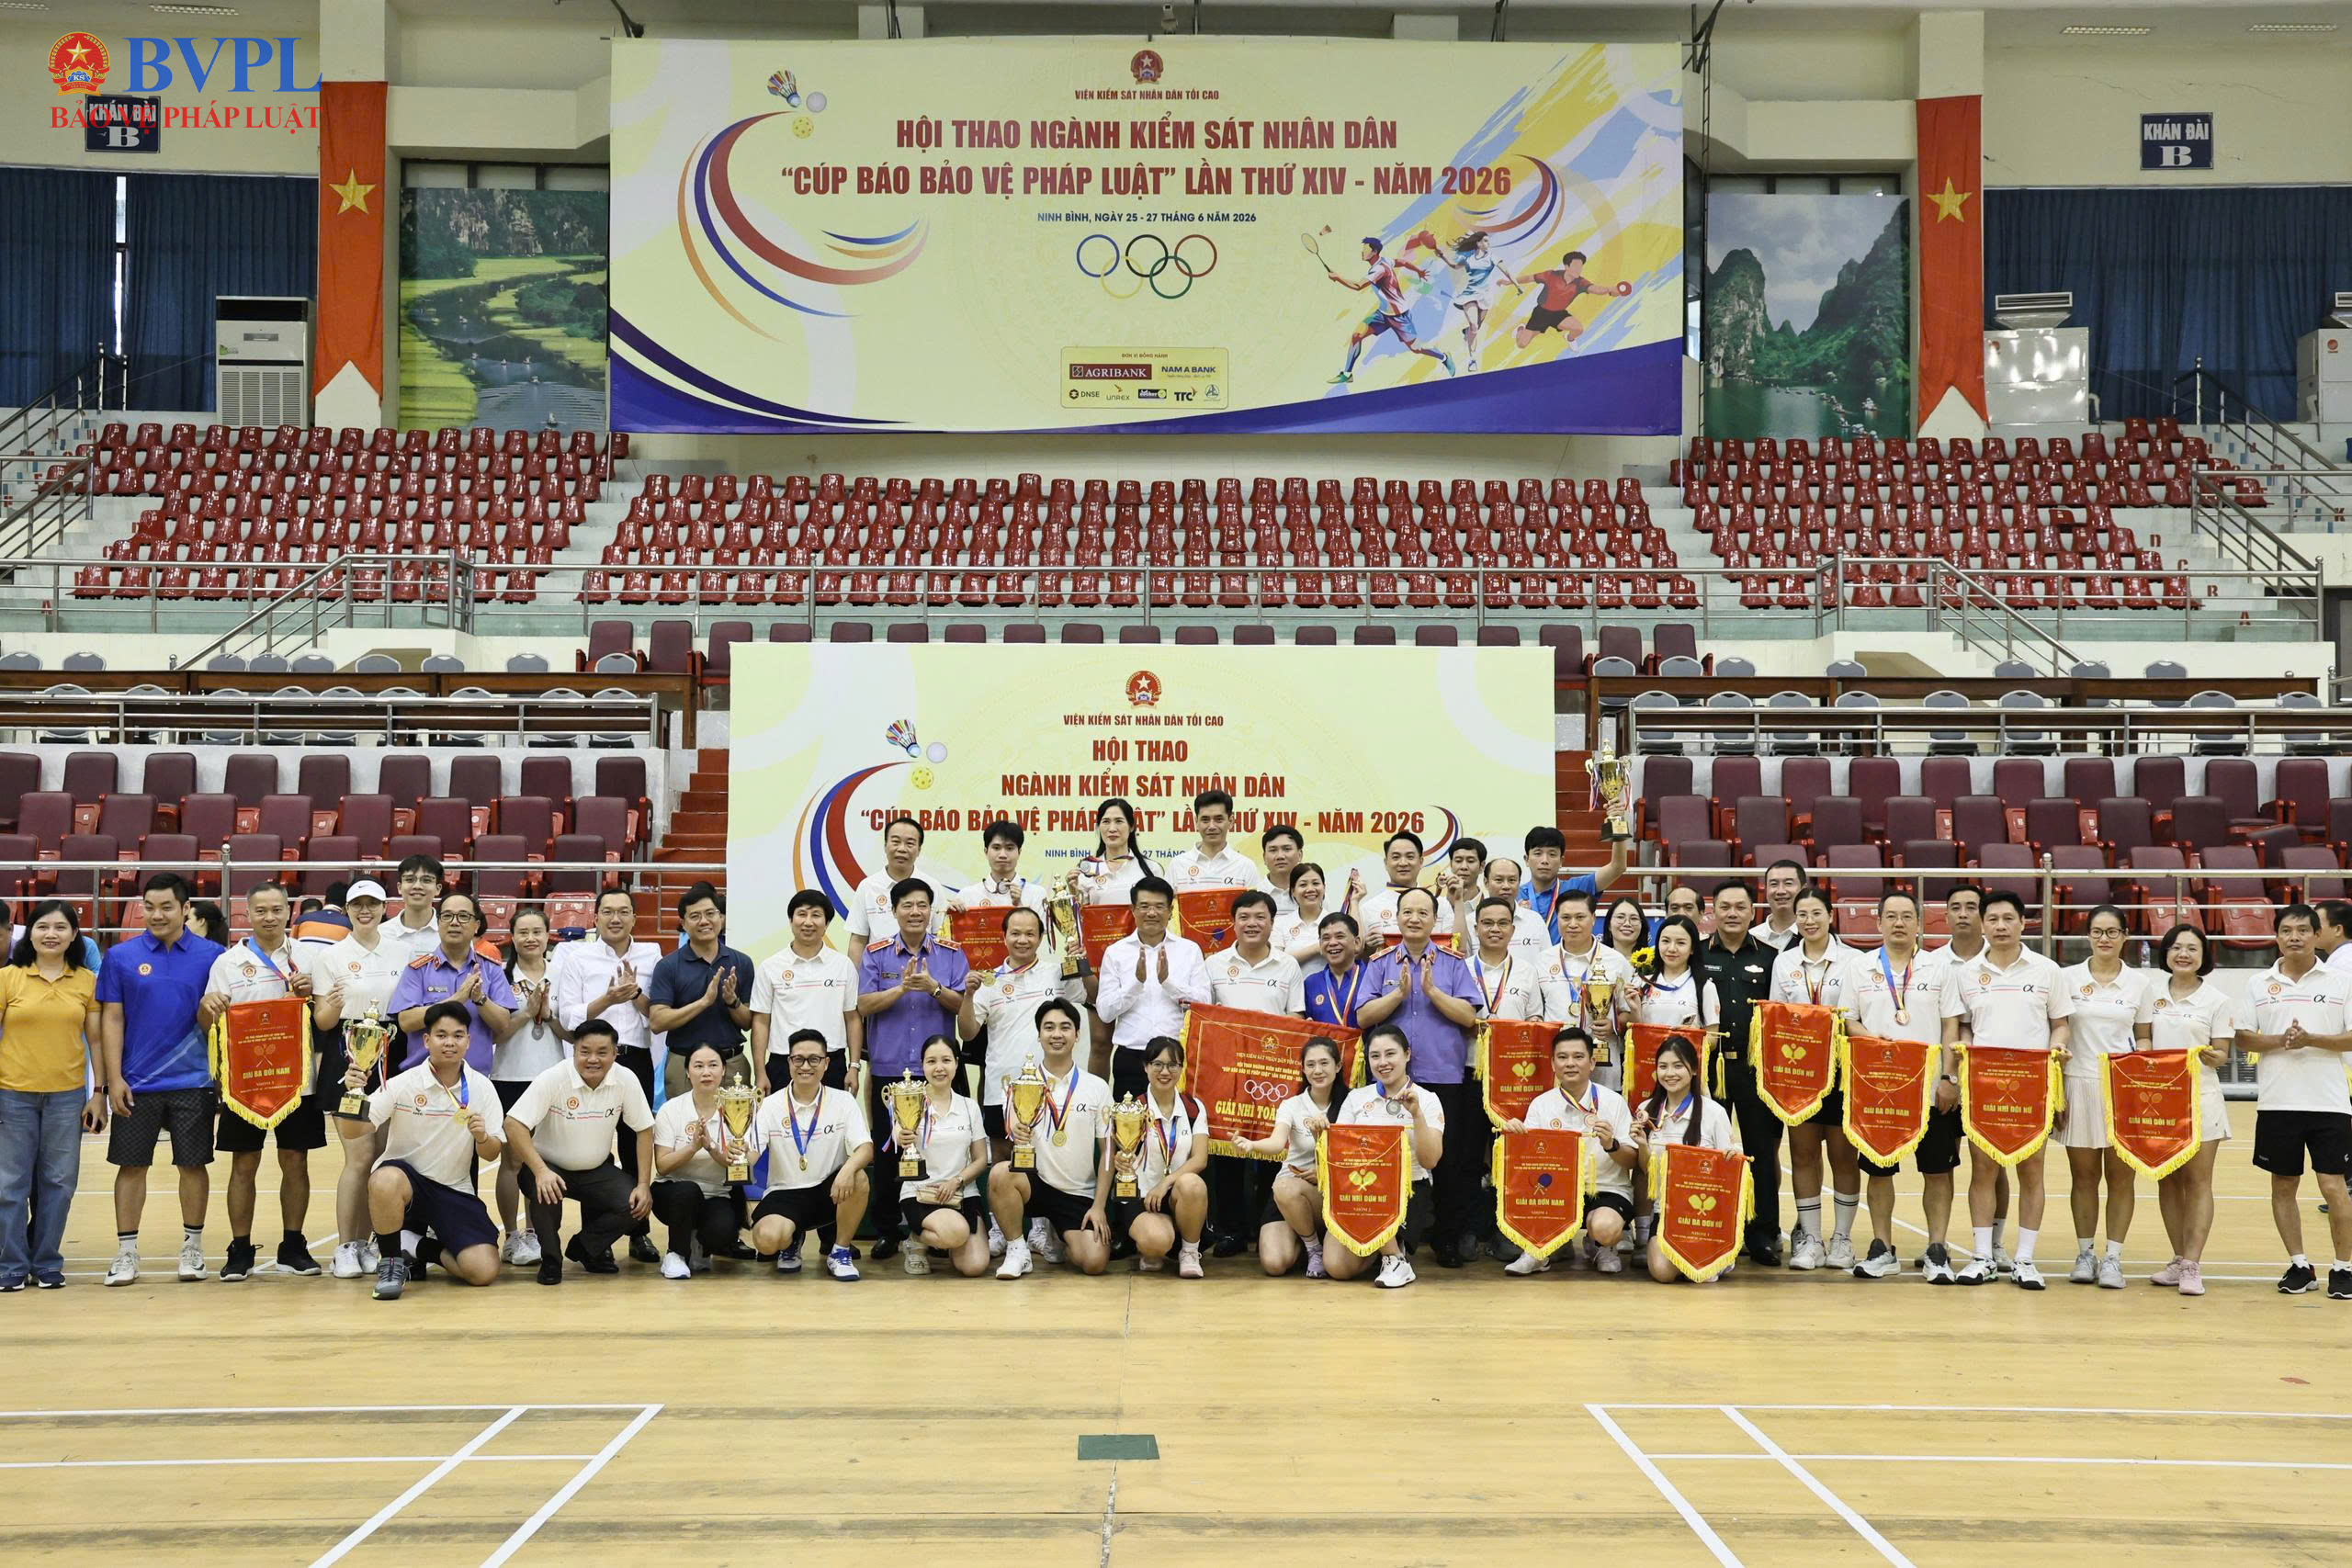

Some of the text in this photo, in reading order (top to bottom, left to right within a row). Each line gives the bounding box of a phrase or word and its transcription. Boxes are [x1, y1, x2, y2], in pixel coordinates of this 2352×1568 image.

[1203, 89, 1219, 100] CAO
[897, 110, 1397, 154] HỘI THAO NGÀNH KIỂM SÁT NHÂN DÂN
[2143, 118, 2210, 141] KHÁN ĐÀI
[2159, 145, 2193, 167] B
[856, 161, 910, 195] BÁO
[920, 159, 973, 195] BẢO
[981, 162, 1014, 199] VỆ
[1023, 162, 1092, 195] PHÁP
[1185, 157, 1232, 196] LẦN
[1240, 162, 1296, 196] THỨ
[1302, 166, 1347, 195] XIV
[1374, 162, 1432, 195] NĂM
[1441, 166, 1511, 196] 2026
[1037, 212, 1062, 222] NINH
[1094, 210, 1123, 222] NGÀY
[1125, 212, 1138, 222] 25
[1146, 212, 1158, 222] 27
[1160, 210, 1196, 222] THÁNG
[1197, 212, 1204, 222] 6
[1206, 210, 1230, 222] NĂM
[1233, 212, 1257, 222] 2026
[1085, 368, 1148, 378] AGRIBANK
[1080, 390, 1101, 399] DNSE
[1063, 712, 1224, 728] VIỆN KIỂM SÁT NHÂN DÂN TỐI CAO
[1092, 736, 1189, 766] HỘI THAO
[1001, 767, 1285, 798] NGÀNH KIỂM SÁT NHÂN DÂN
[919, 806, 960, 831] BÁO
[1015, 806, 1040, 836] VỆ
[1263, 811, 1298, 832] XIV
[1317, 808, 1364, 833] NĂM
[1370, 811, 1425, 834] 2026
[1045, 849, 1067, 858] NINH
[1216, 1099, 1236, 1116] GIẢI
[1237, 1101, 1255, 1117] NHÌ
